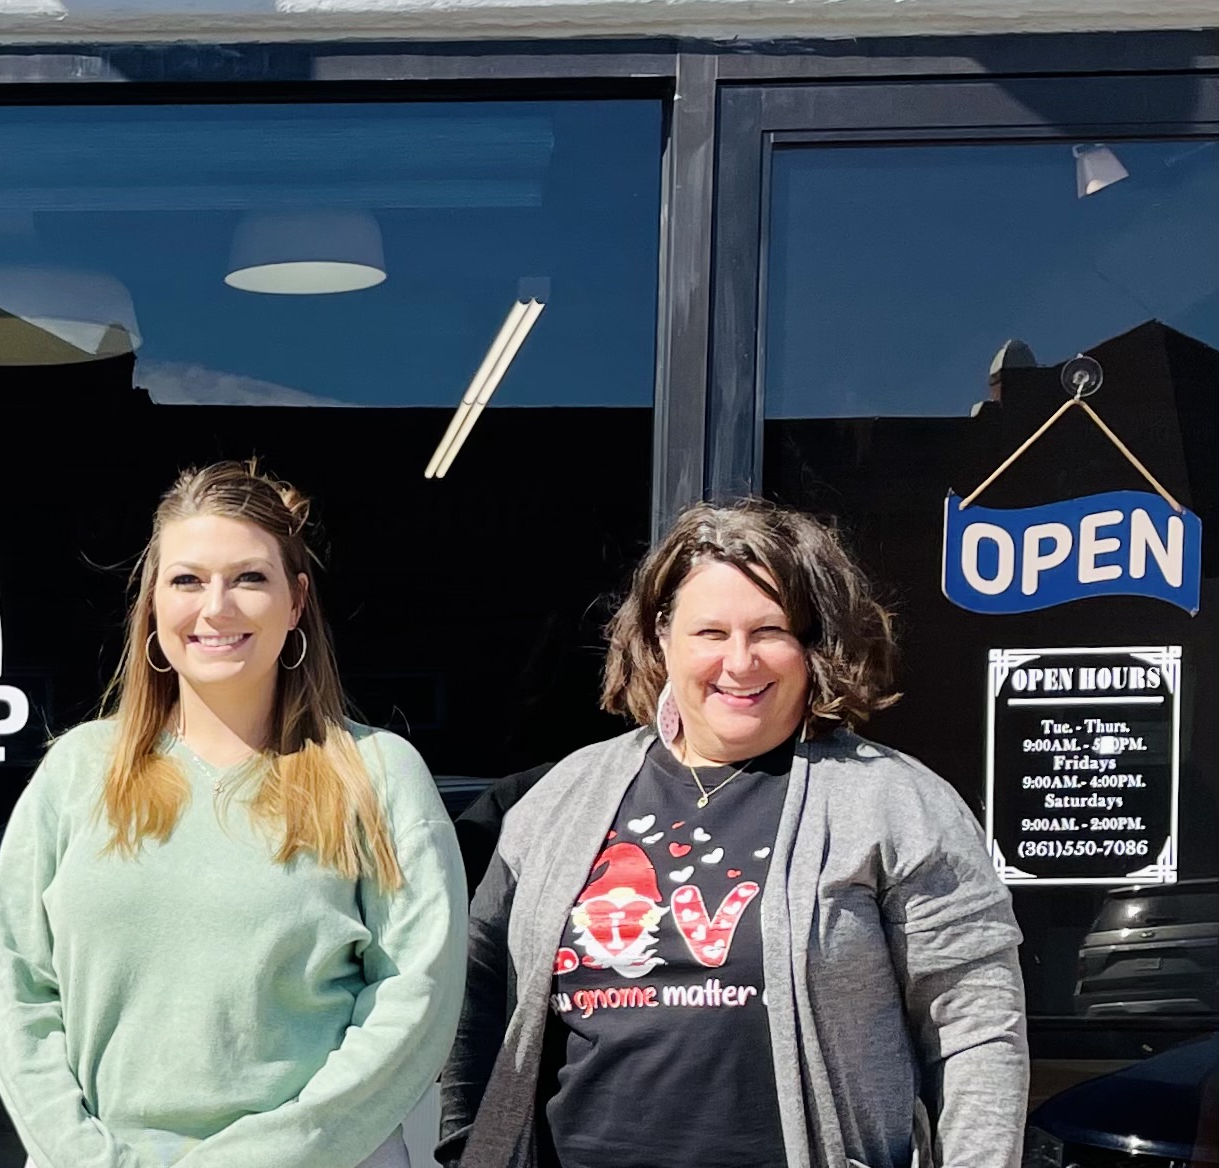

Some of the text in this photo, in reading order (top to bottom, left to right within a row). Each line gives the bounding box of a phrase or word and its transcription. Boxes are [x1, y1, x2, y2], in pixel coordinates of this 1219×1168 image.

[960, 507, 1185, 597] OPEN
[1011, 666, 1161, 692] OPEN HOURS
[1040, 719, 1074, 735] Tue.
[1083, 718, 1131, 734] Thurs.
[1052, 755, 1117, 772] Fridays
[1089, 774, 1147, 788] 4:00PM.
[1043, 792, 1124, 811] Saturdays
[1089, 817, 1147, 831] 2:00PM.
[1017, 839, 1149, 859] (361)550-7086
[573, 986, 659, 1019] gnome
[662, 978, 758, 1008] matter
